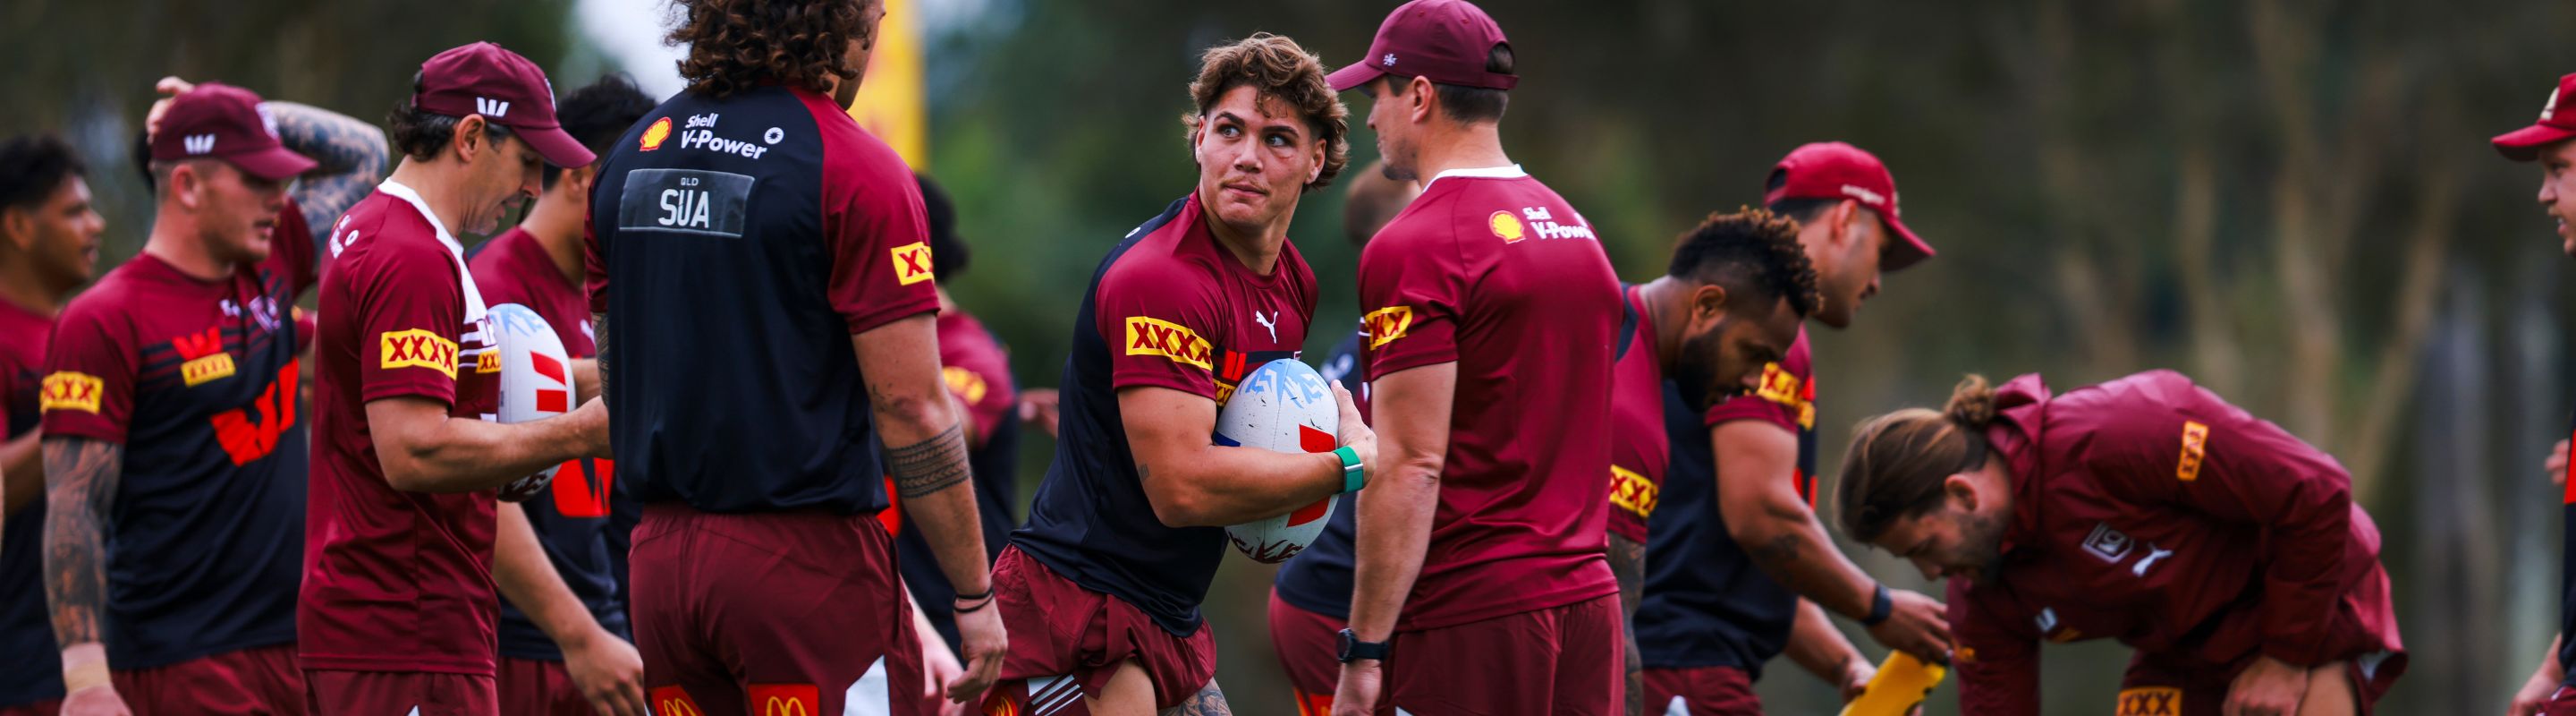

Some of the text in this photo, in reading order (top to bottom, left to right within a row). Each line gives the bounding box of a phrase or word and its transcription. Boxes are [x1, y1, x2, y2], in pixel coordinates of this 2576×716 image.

[684, 113, 719, 129] Shell
[681, 130, 767, 159] V-Power
[658, 188, 710, 229] SUA
[388, 334, 455, 372] XXXX
